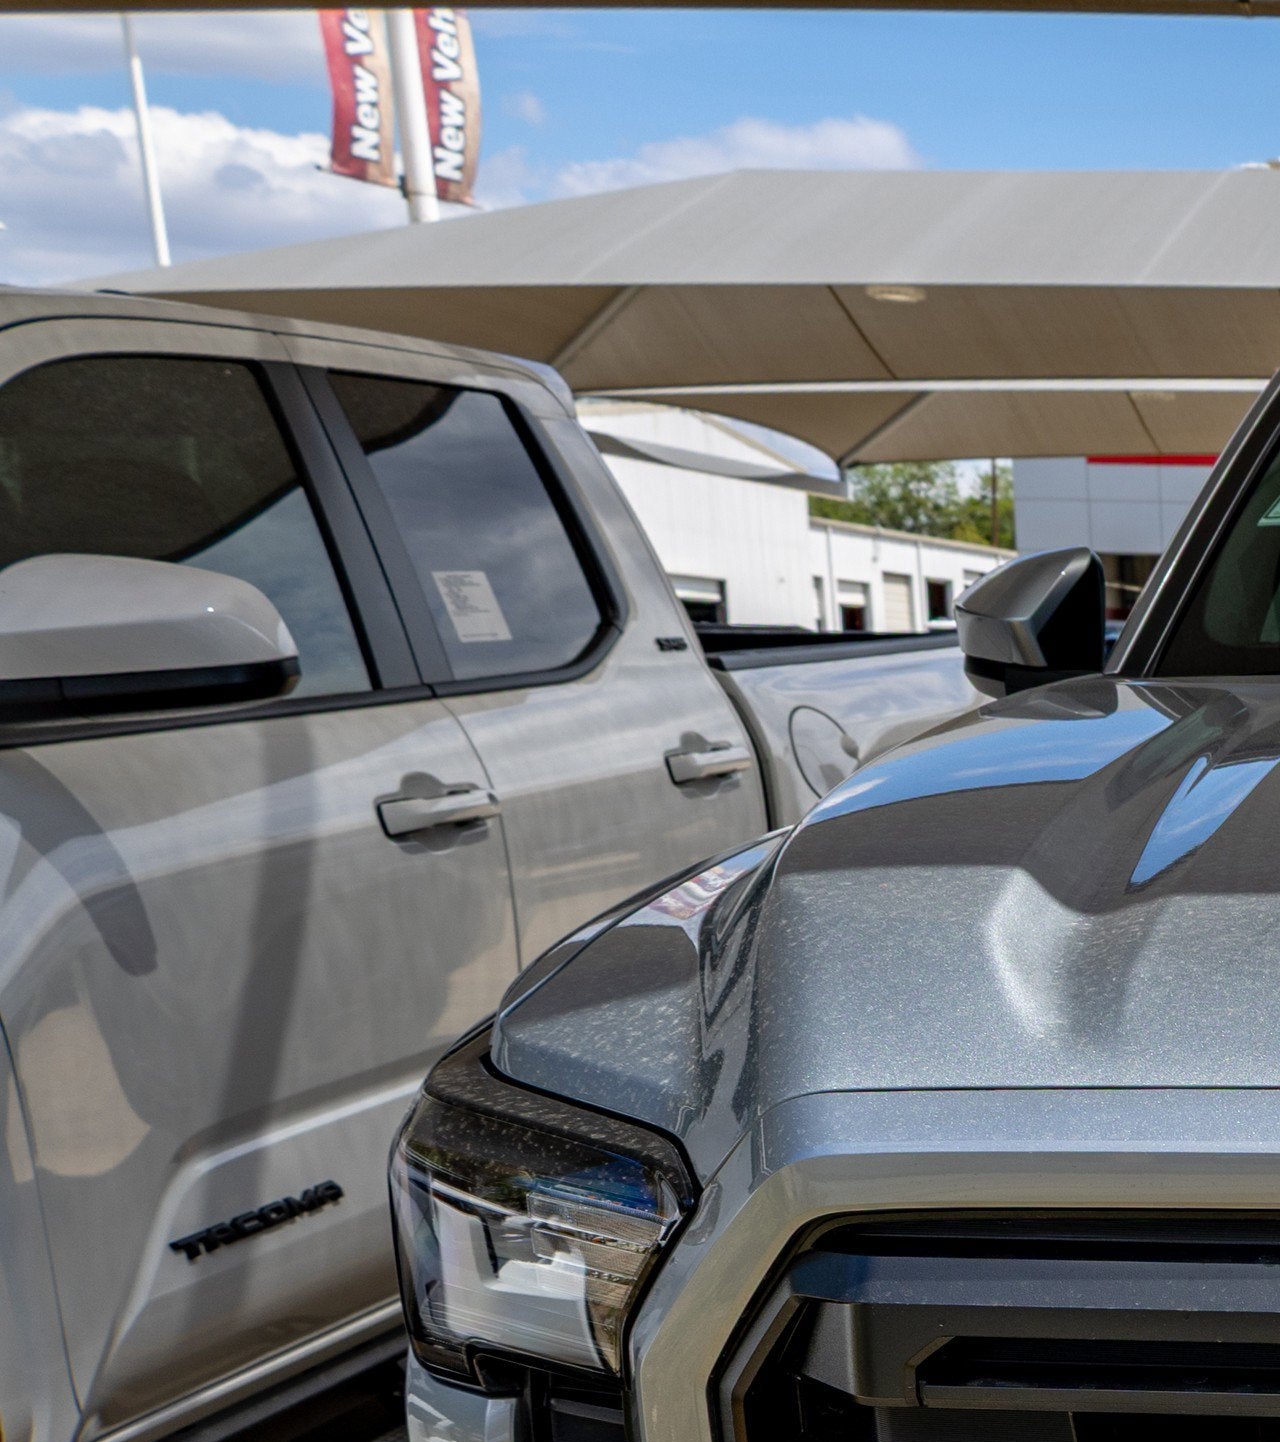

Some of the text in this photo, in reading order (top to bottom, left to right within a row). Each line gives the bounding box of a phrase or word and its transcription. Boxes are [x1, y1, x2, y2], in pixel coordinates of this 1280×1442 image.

[350, 62, 381, 162] New
[434, 86, 466, 183] New
[168, 1179, 345, 1261] TACOMA
